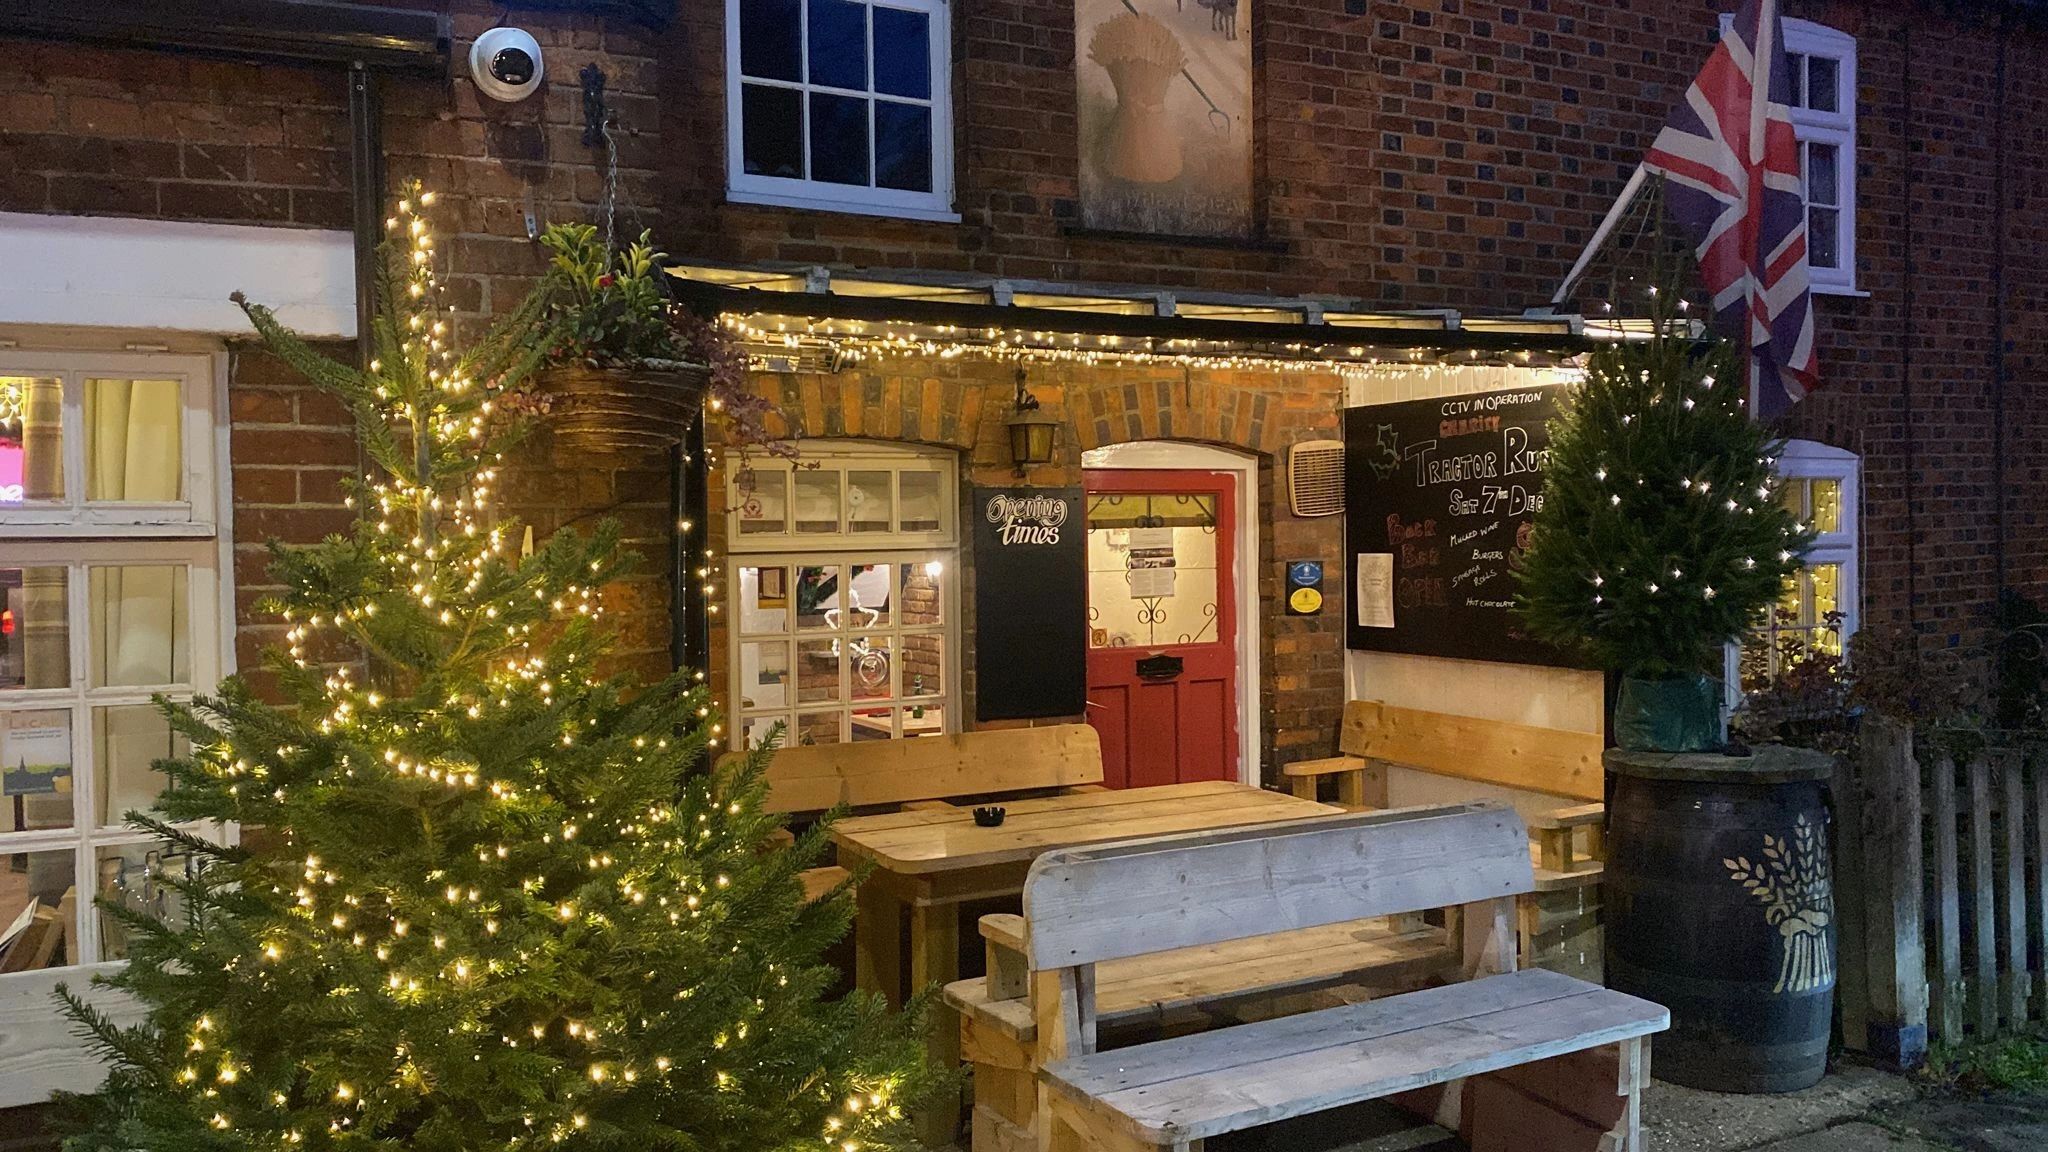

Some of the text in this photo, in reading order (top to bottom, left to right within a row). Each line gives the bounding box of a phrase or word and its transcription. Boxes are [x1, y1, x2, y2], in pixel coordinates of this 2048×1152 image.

[1441, 391, 1543, 416] CCTV IN OPERATION
[1404, 439, 1498, 487] TRACTOR
[986, 494, 1068, 528] Opening
[1449, 488, 1479, 516] SAT
[1508, 485, 1544, 517] DEC
[996, 513, 1060, 546] times
[1450, 530, 1478, 547] MULLED
[1472, 549, 1504, 561] BURGERS
[1473, 568, 1498, 587] ROLLS
[1466, 597, 1478, 607] HOT
